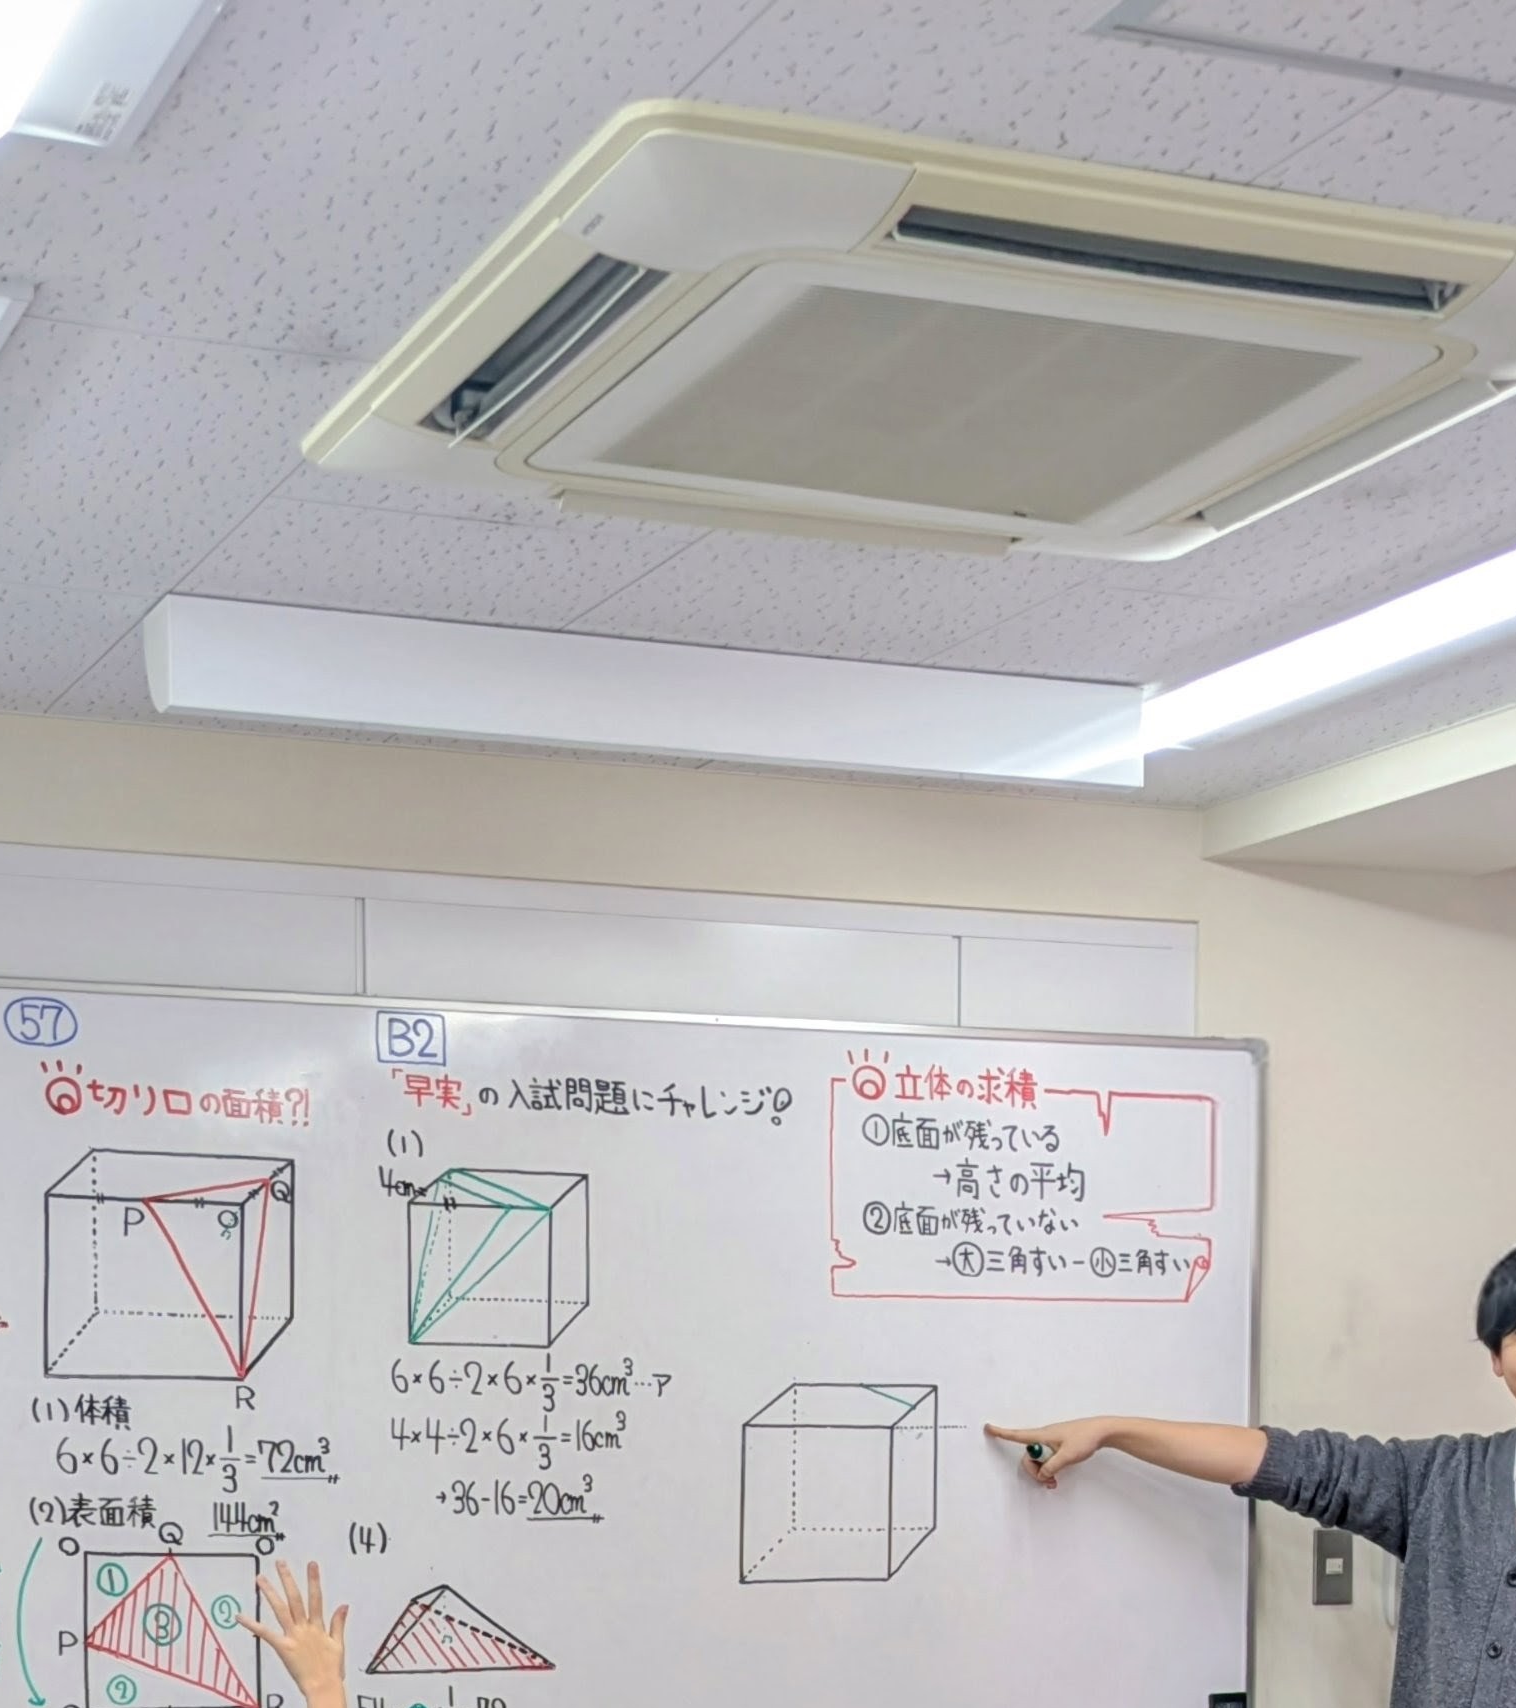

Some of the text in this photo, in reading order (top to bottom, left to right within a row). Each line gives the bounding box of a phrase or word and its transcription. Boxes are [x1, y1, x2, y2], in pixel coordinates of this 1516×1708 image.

[18, 1003, 65, 1042] 57
[386, 1018, 439, 1058] B2
[894, 1064, 1039, 1109] 立体の求積
[955, 1158, 1086, 1201] 高さの平均
[122, 1206, 147, 1238] P
[234, 1384, 258, 1412] R
[348, 1521, 389, 1555] (4)
[58, 1630, 79, 1656] P
